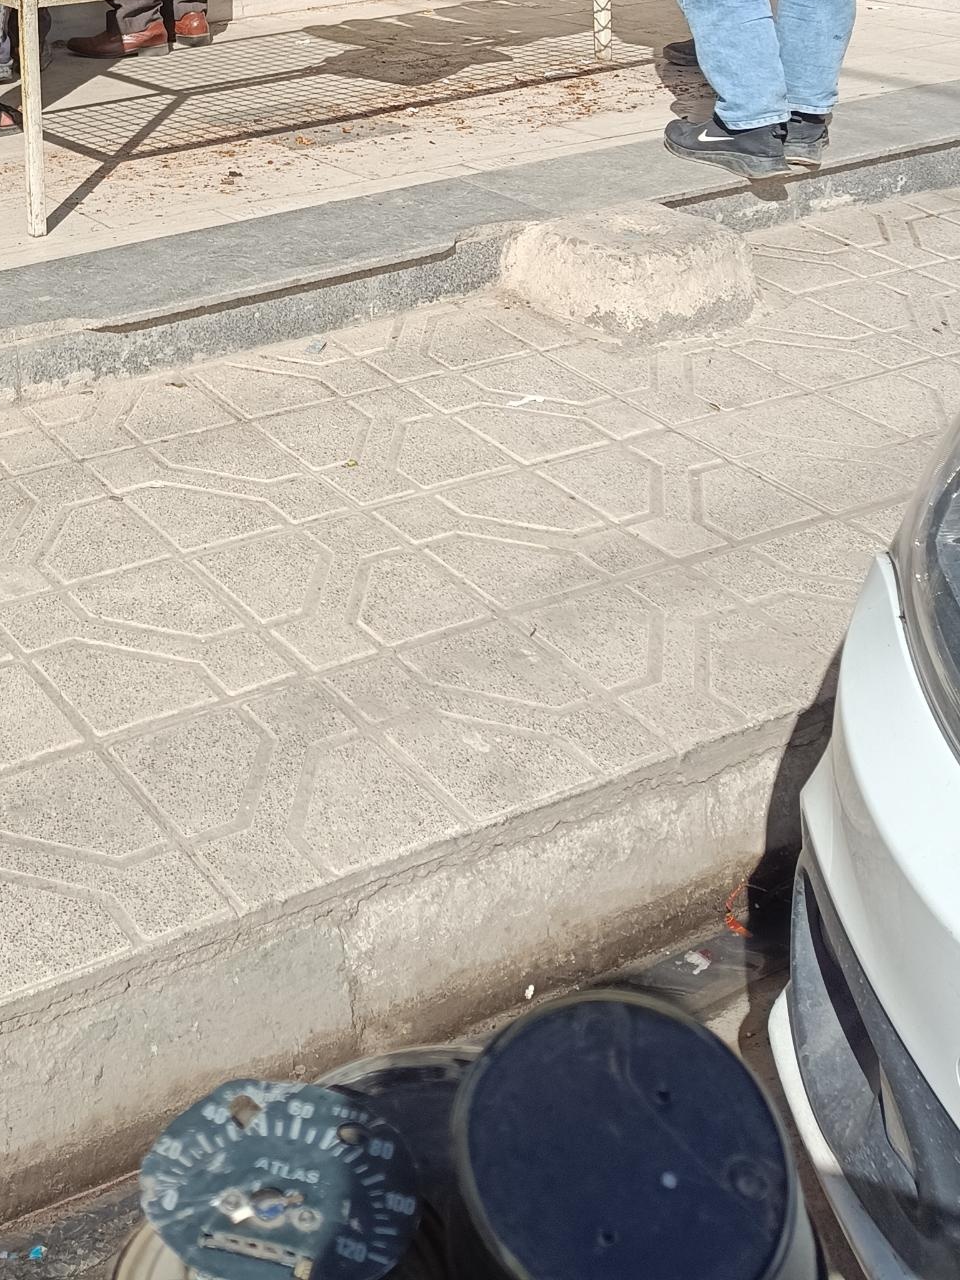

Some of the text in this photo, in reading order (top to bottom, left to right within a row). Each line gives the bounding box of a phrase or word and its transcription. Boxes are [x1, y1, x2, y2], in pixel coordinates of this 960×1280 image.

[288, 1099, 316, 1120] 60
[154, 1134, 184, 1161] 20
[254, 1157, 321, 1184] ATLAS
